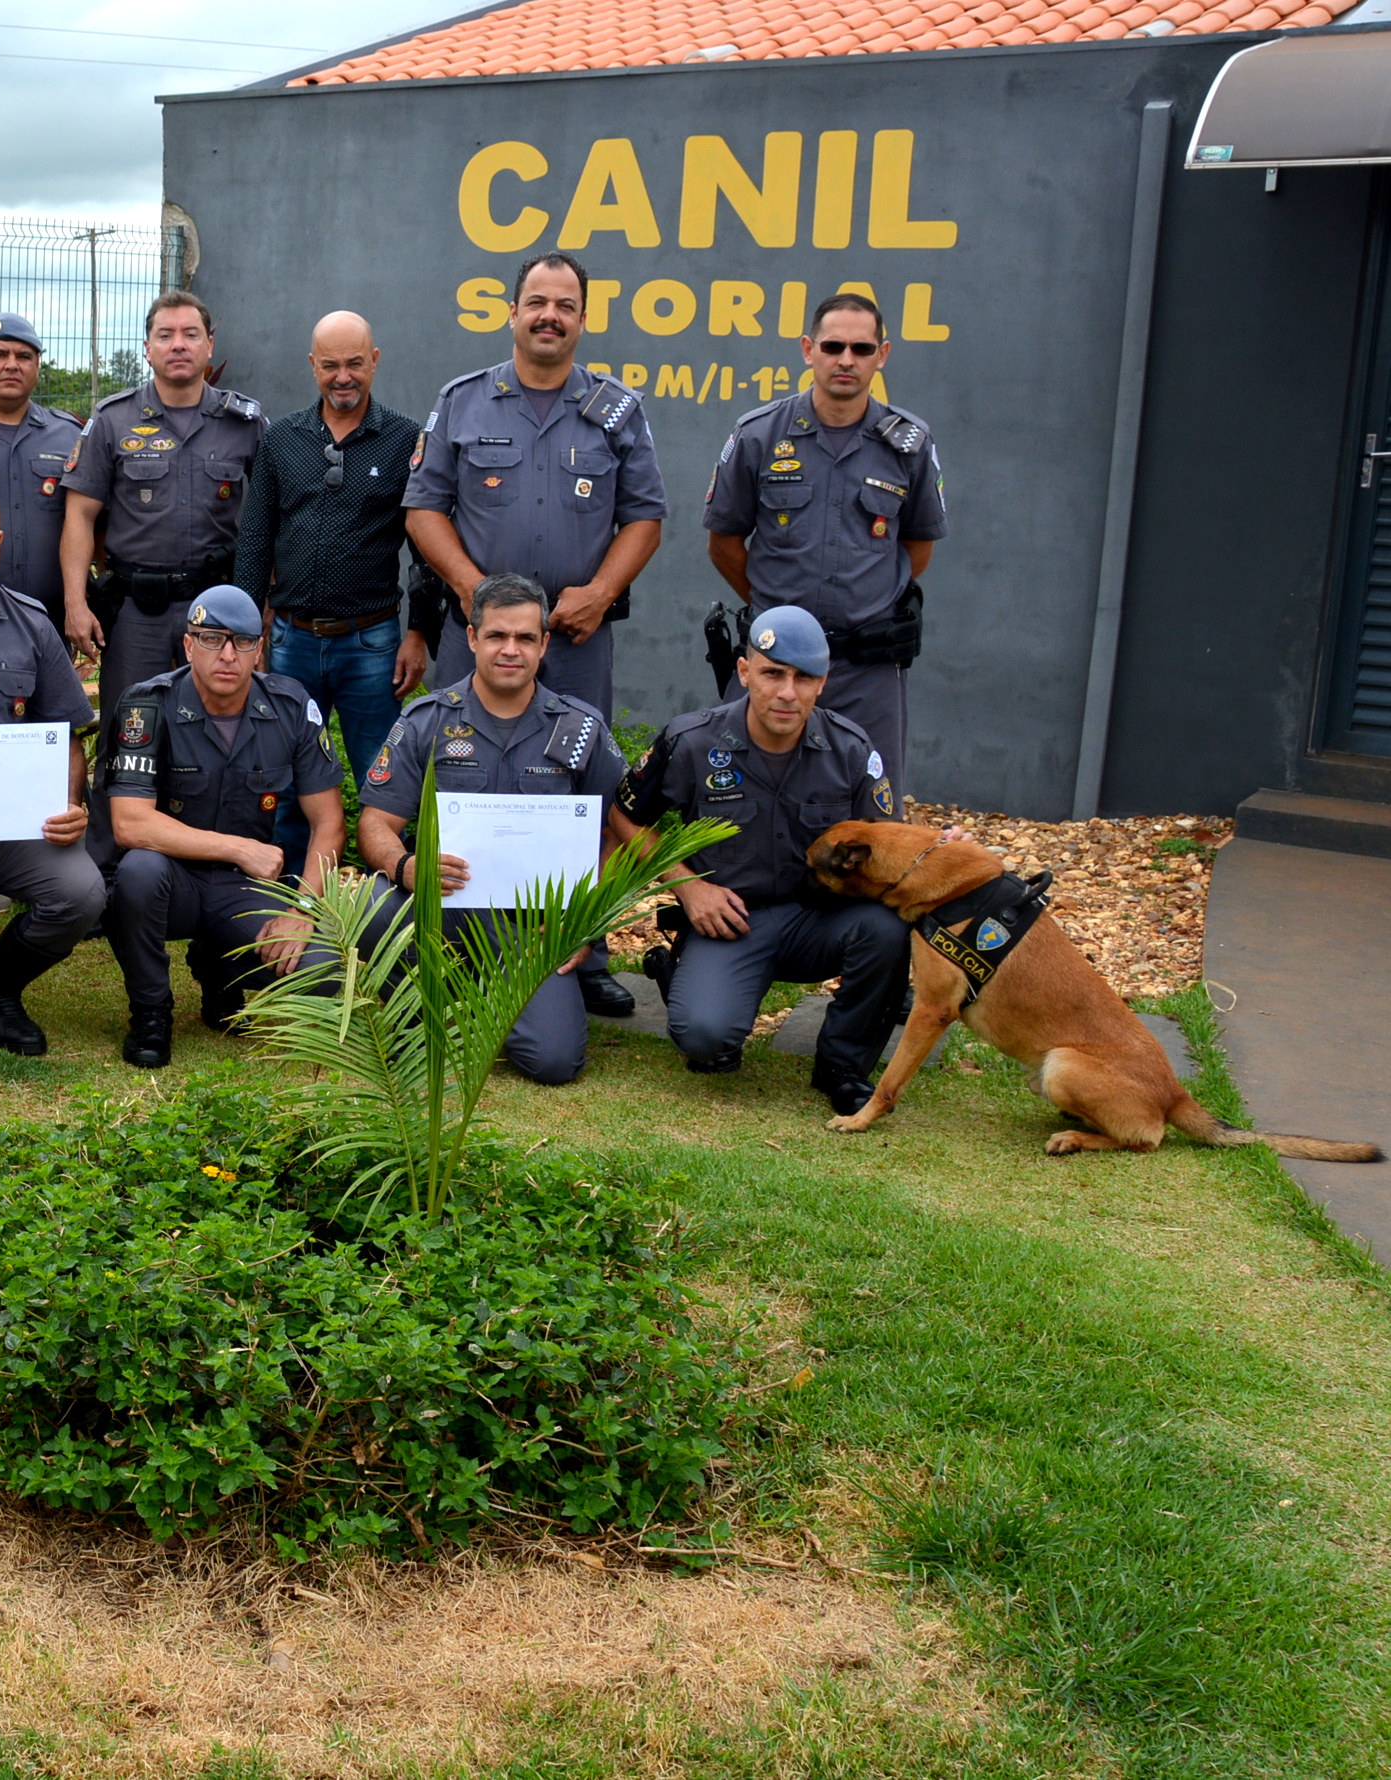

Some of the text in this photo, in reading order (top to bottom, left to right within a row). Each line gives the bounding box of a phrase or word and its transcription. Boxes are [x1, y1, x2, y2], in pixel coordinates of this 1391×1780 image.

[458, 129, 958, 253] CANIL
[456, 277, 951, 342] STORIL
[934, 934, 985, 979] POLÍCIA
